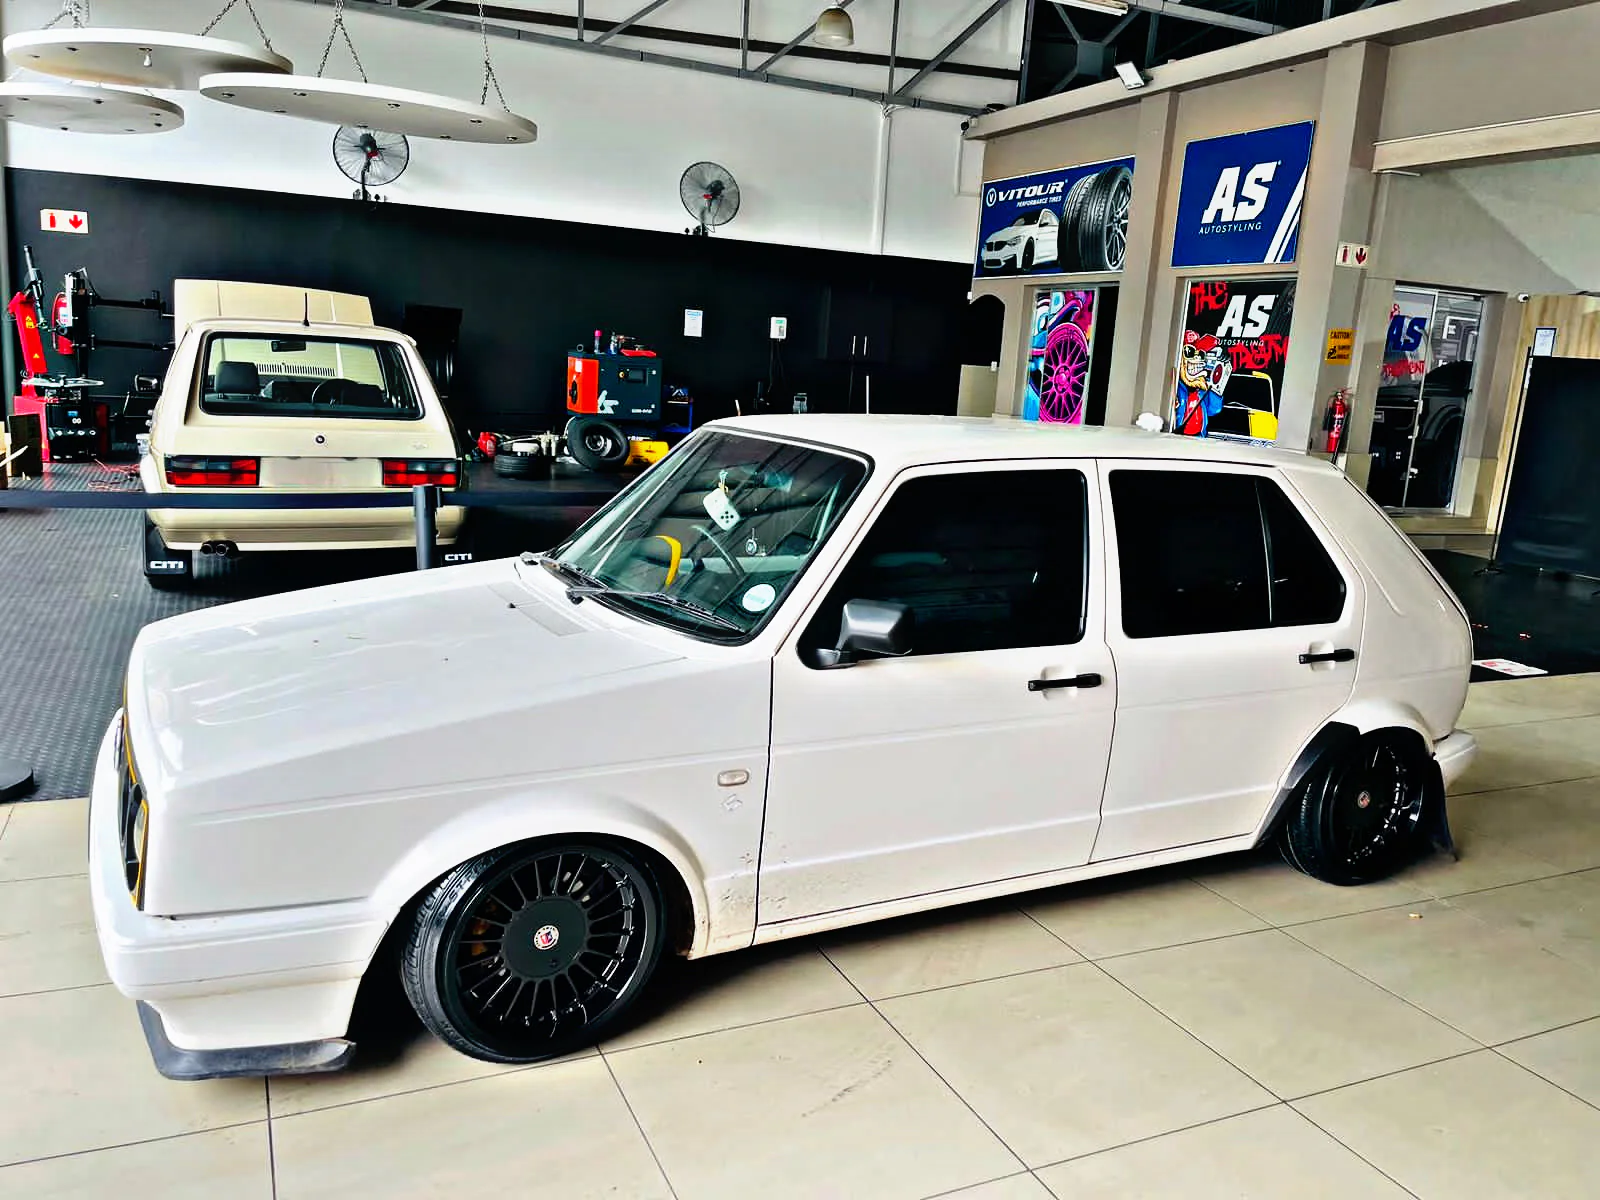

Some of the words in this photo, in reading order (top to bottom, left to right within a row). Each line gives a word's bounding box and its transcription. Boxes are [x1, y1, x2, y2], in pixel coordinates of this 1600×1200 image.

[998, 181, 1065, 202] VITOUR
[1201, 161, 1278, 224] AS
[1016, 197, 1048, 208] PERFORMANCE
[1198, 221, 1262, 235] AUTOSTYLING
[1215, 294, 1276, 338] AS
[1386, 315, 1427, 352] AS
[1214, 339, 1264, 347] AUTOSTYLING
[444, 553, 472, 561] CITI
[150, 560, 184, 569] CITI
